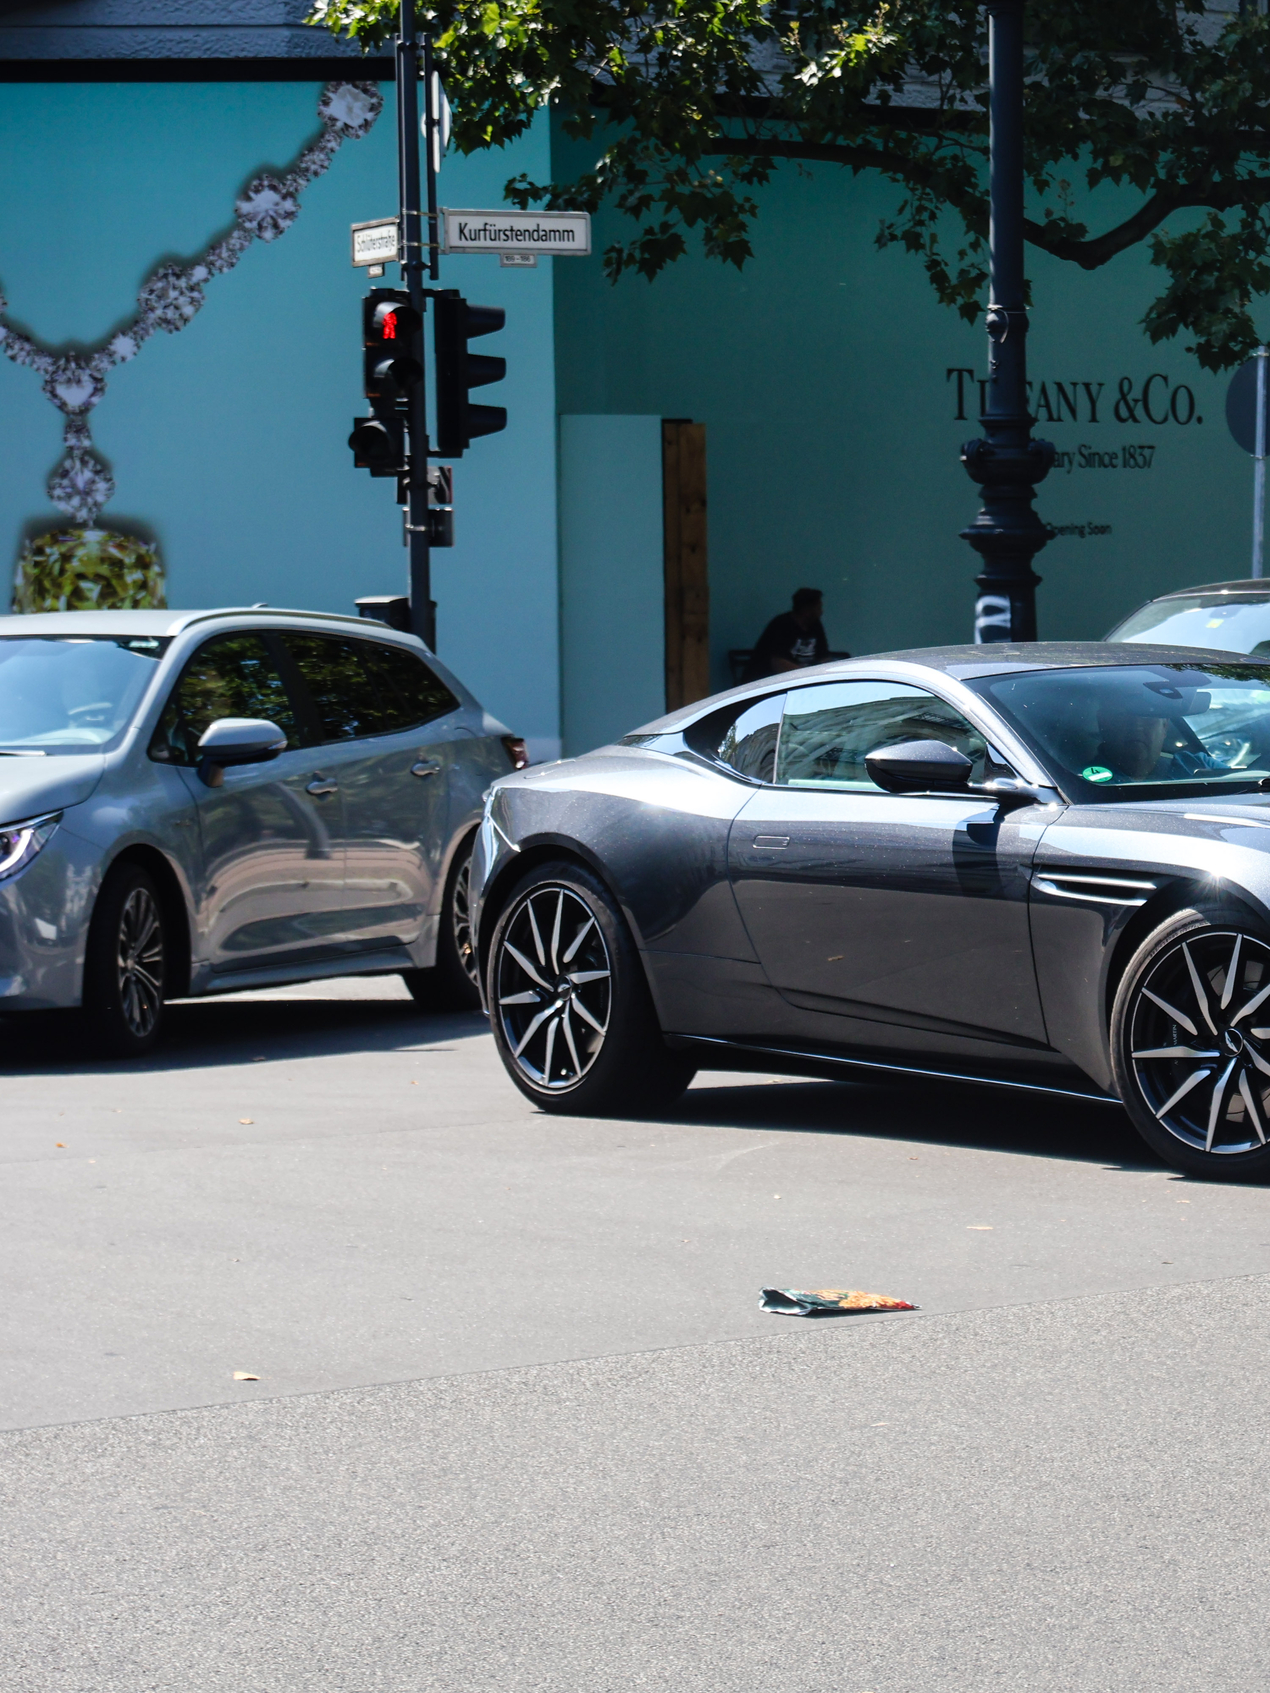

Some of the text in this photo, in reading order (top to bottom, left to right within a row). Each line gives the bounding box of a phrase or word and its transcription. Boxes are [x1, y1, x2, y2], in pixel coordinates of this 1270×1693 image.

[458, 222, 575, 242] Kurfürstendamm
[946, 368, 1105, 423] TIANY
[1078, 444, 1118, 469] Since
[1120, 444, 1156, 469] 1837
